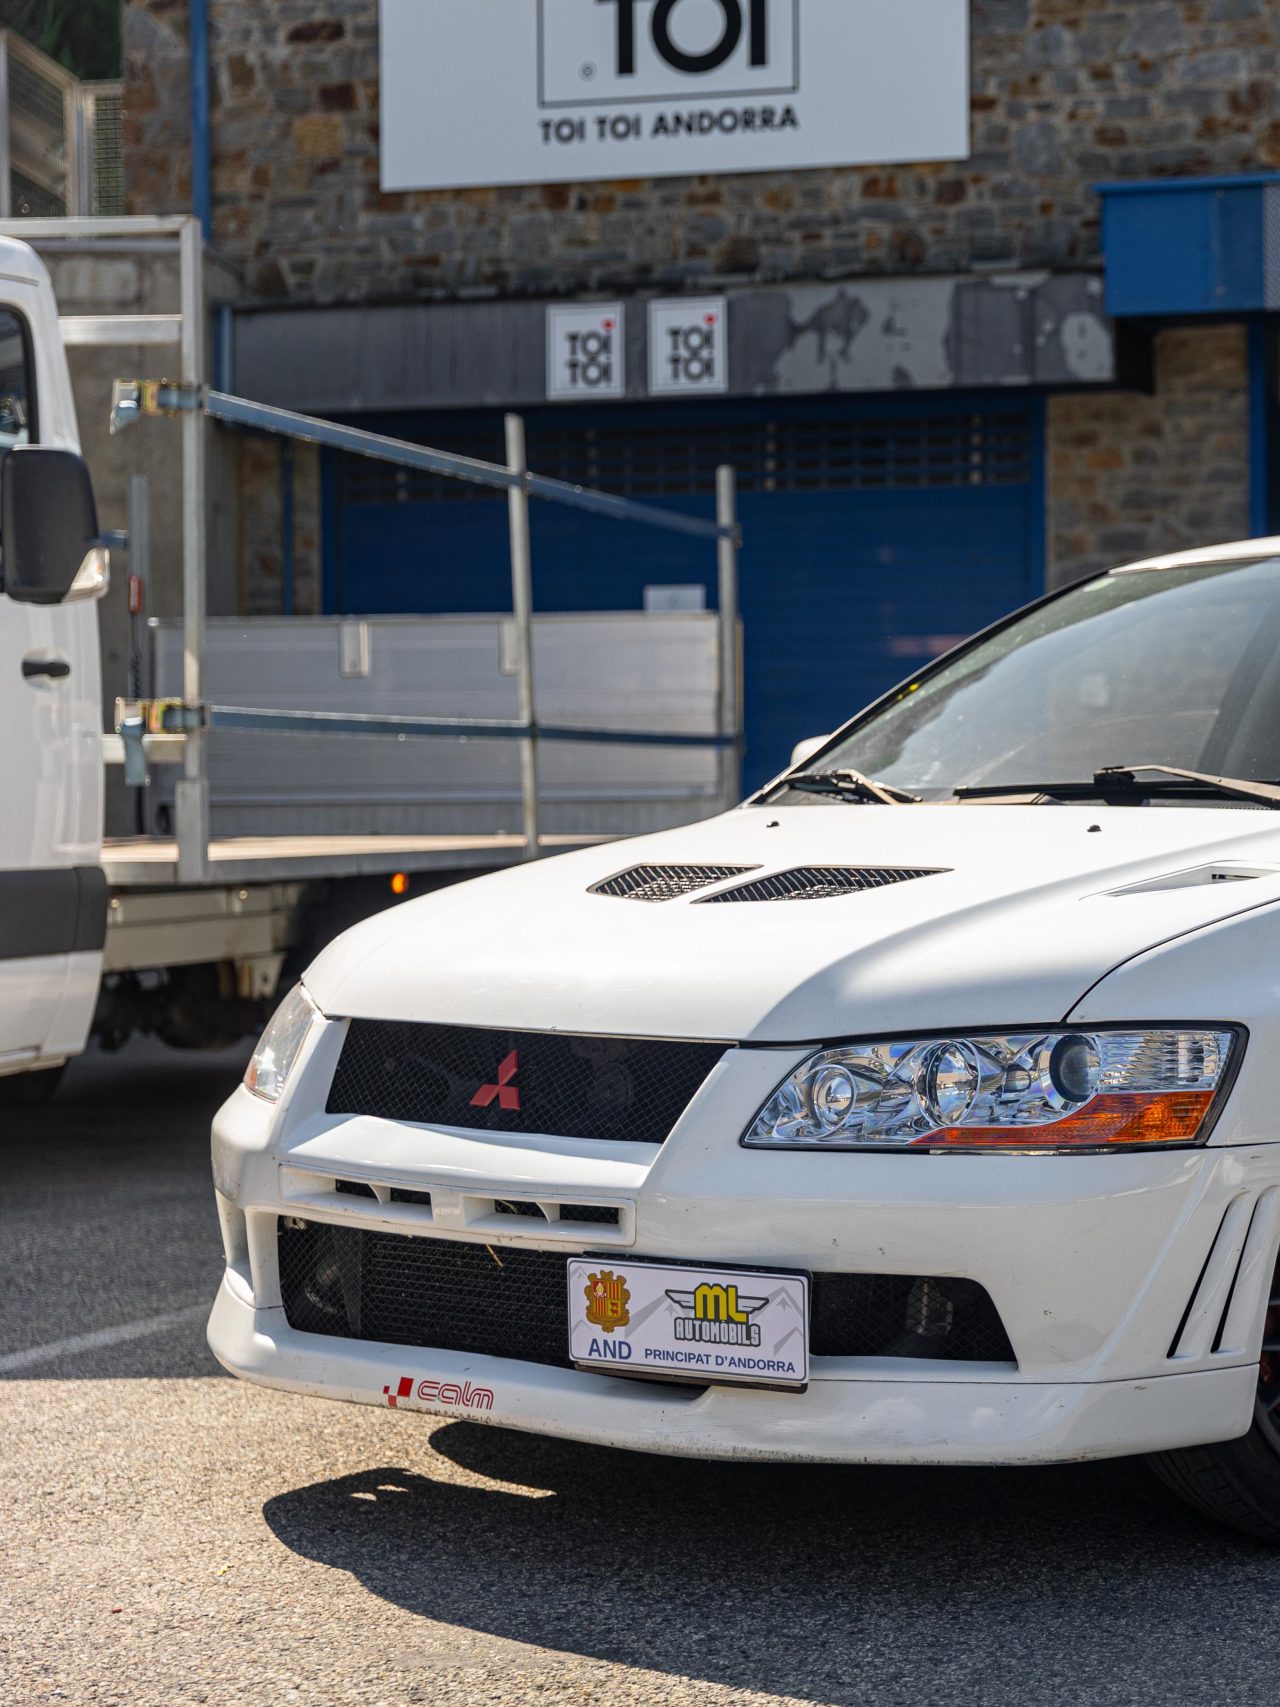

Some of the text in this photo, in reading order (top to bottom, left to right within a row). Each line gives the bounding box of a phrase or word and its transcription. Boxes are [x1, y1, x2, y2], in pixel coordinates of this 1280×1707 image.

[595, 0, 767, 76] TOI
[539, 105, 798, 144] TOI TOI ANDORRA
[566, 358, 612, 386] TOI
[668, 353, 714, 381] TOI
[694, 1283, 749, 1323] ML
[588, 1338, 632, 1361] AND
[644, 1348, 796, 1374] PRINCIPAT D'ANDORRA
[417, 1380, 494, 1411] calm
